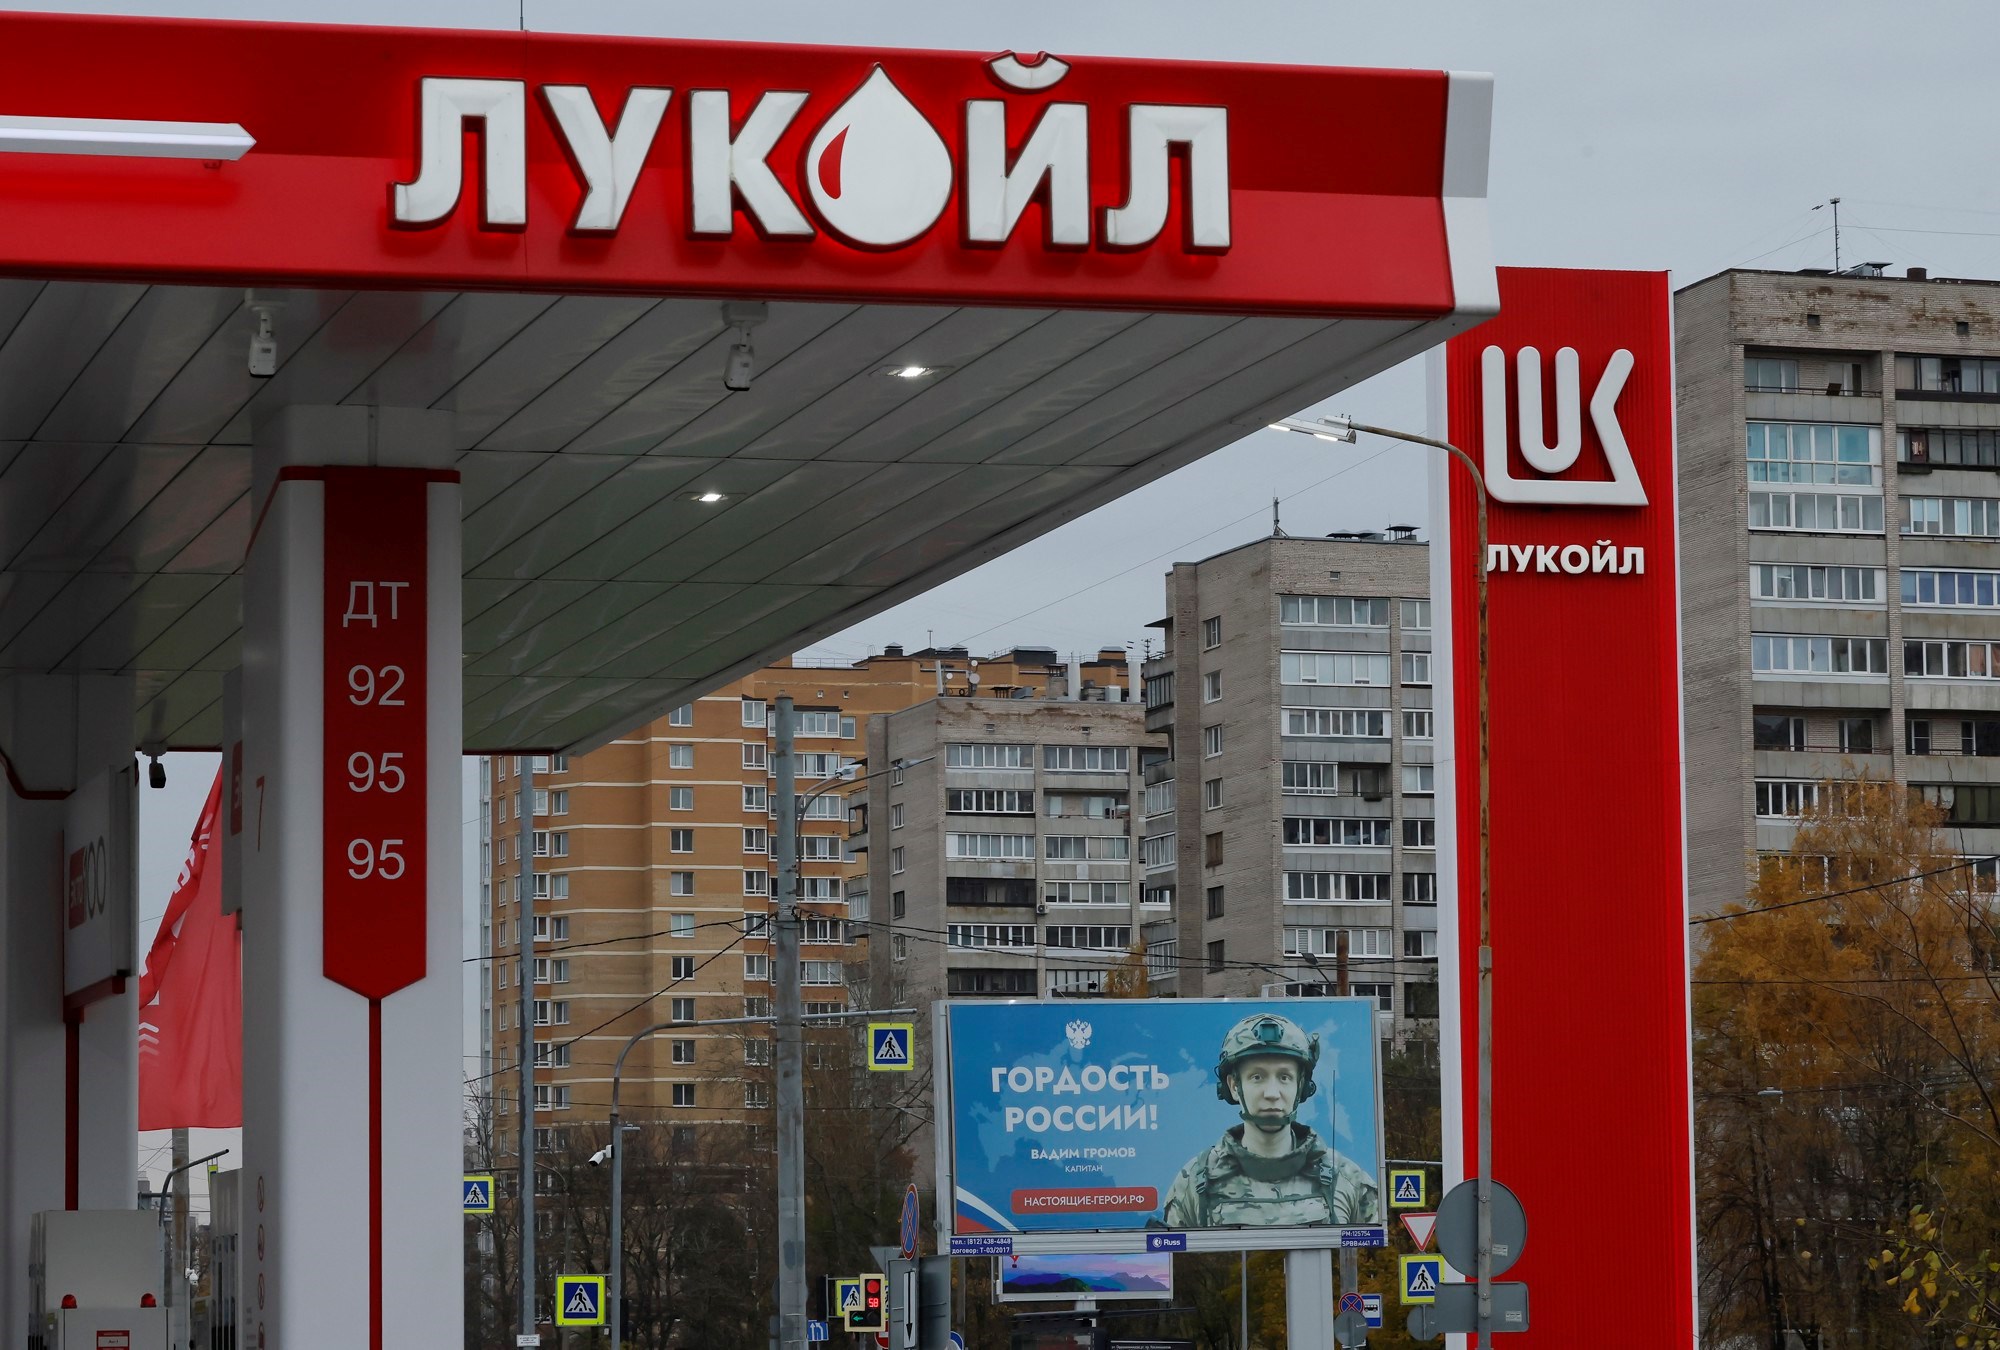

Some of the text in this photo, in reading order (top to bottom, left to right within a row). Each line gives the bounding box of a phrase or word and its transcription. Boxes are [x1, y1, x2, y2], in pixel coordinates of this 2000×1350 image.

[393, 51, 1233, 254] ЛУКОЙЛ
[1486, 539, 1645, 575] ЛУКОЙЛ
[342, 581, 409, 628] ДТ
[348, 664, 406, 706] 92
[347, 751, 406, 793] 95
[347, 838, 406, 880] 95
[991, 1065, 1170, 1095] ГОРДОСТЬ
[1005, 1104, 1158, 1133] РОССИИ!
[1031, 1147, 1137, 1160] ВАДИМ ГРОМОВ
[1065, 1164, 1103, 1173] КАПИТАН
[1024, 1194, 1145, 1207] НАСТОЯЩИЕ-ГЕРОИ.РФ
[1163, 1238, 1181, 1246] Russ
[868, 1297, 879, 1308] 58
